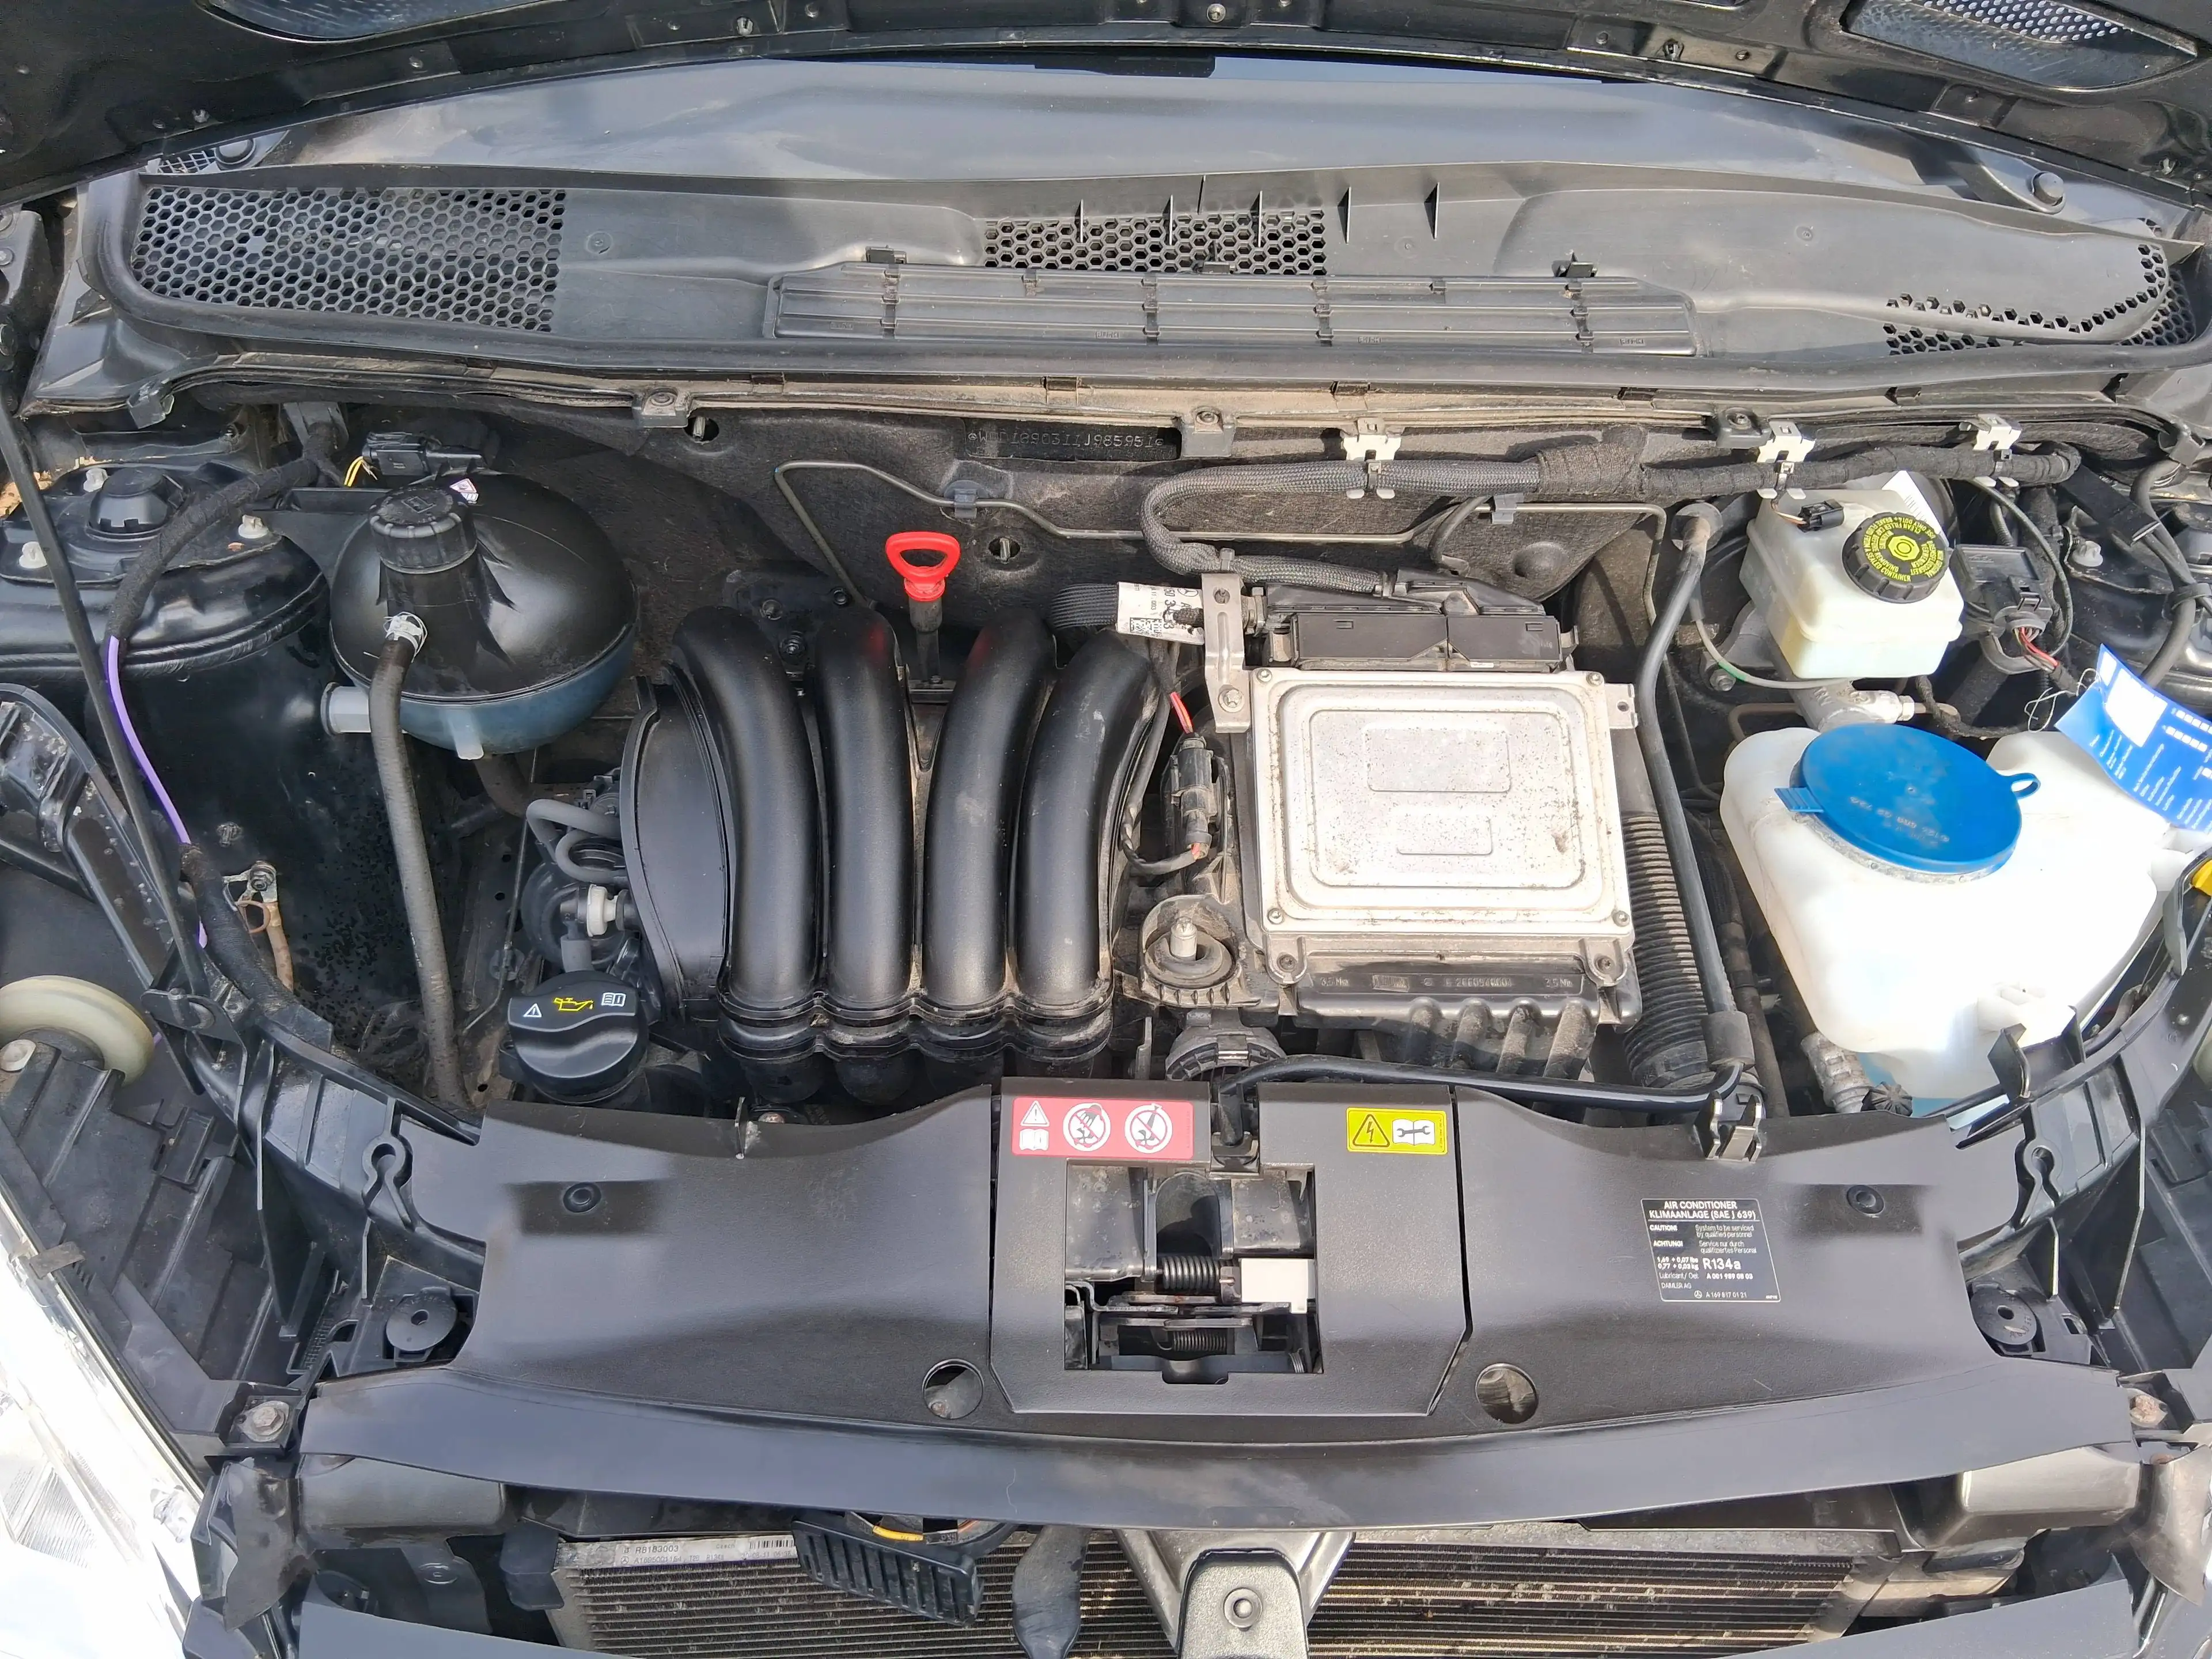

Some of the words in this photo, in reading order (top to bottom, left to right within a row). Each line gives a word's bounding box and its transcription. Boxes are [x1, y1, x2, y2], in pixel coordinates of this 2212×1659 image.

[1903, 523, 1922, 534] CLEAN
[1914, 520, 1927, 531] ONLY
[1866, 552, 1883, 569] SEALED
[1874, 552, 1899, 573] REMOVING
[1880, 569, 1911, 582] CONTAINER
[1664, 1201, 1678, 1209] AIR
[1680, 1201, 1737, 1209] CONDITIONER
[1649, 1210, 1710, 1219] KLIMAANLAGE
[1710, 1210, 1730, 1221] (SAE
[1737, 1210, 1756, 1221] 639)
[1702, 1257, 1741, 1270] R134a
